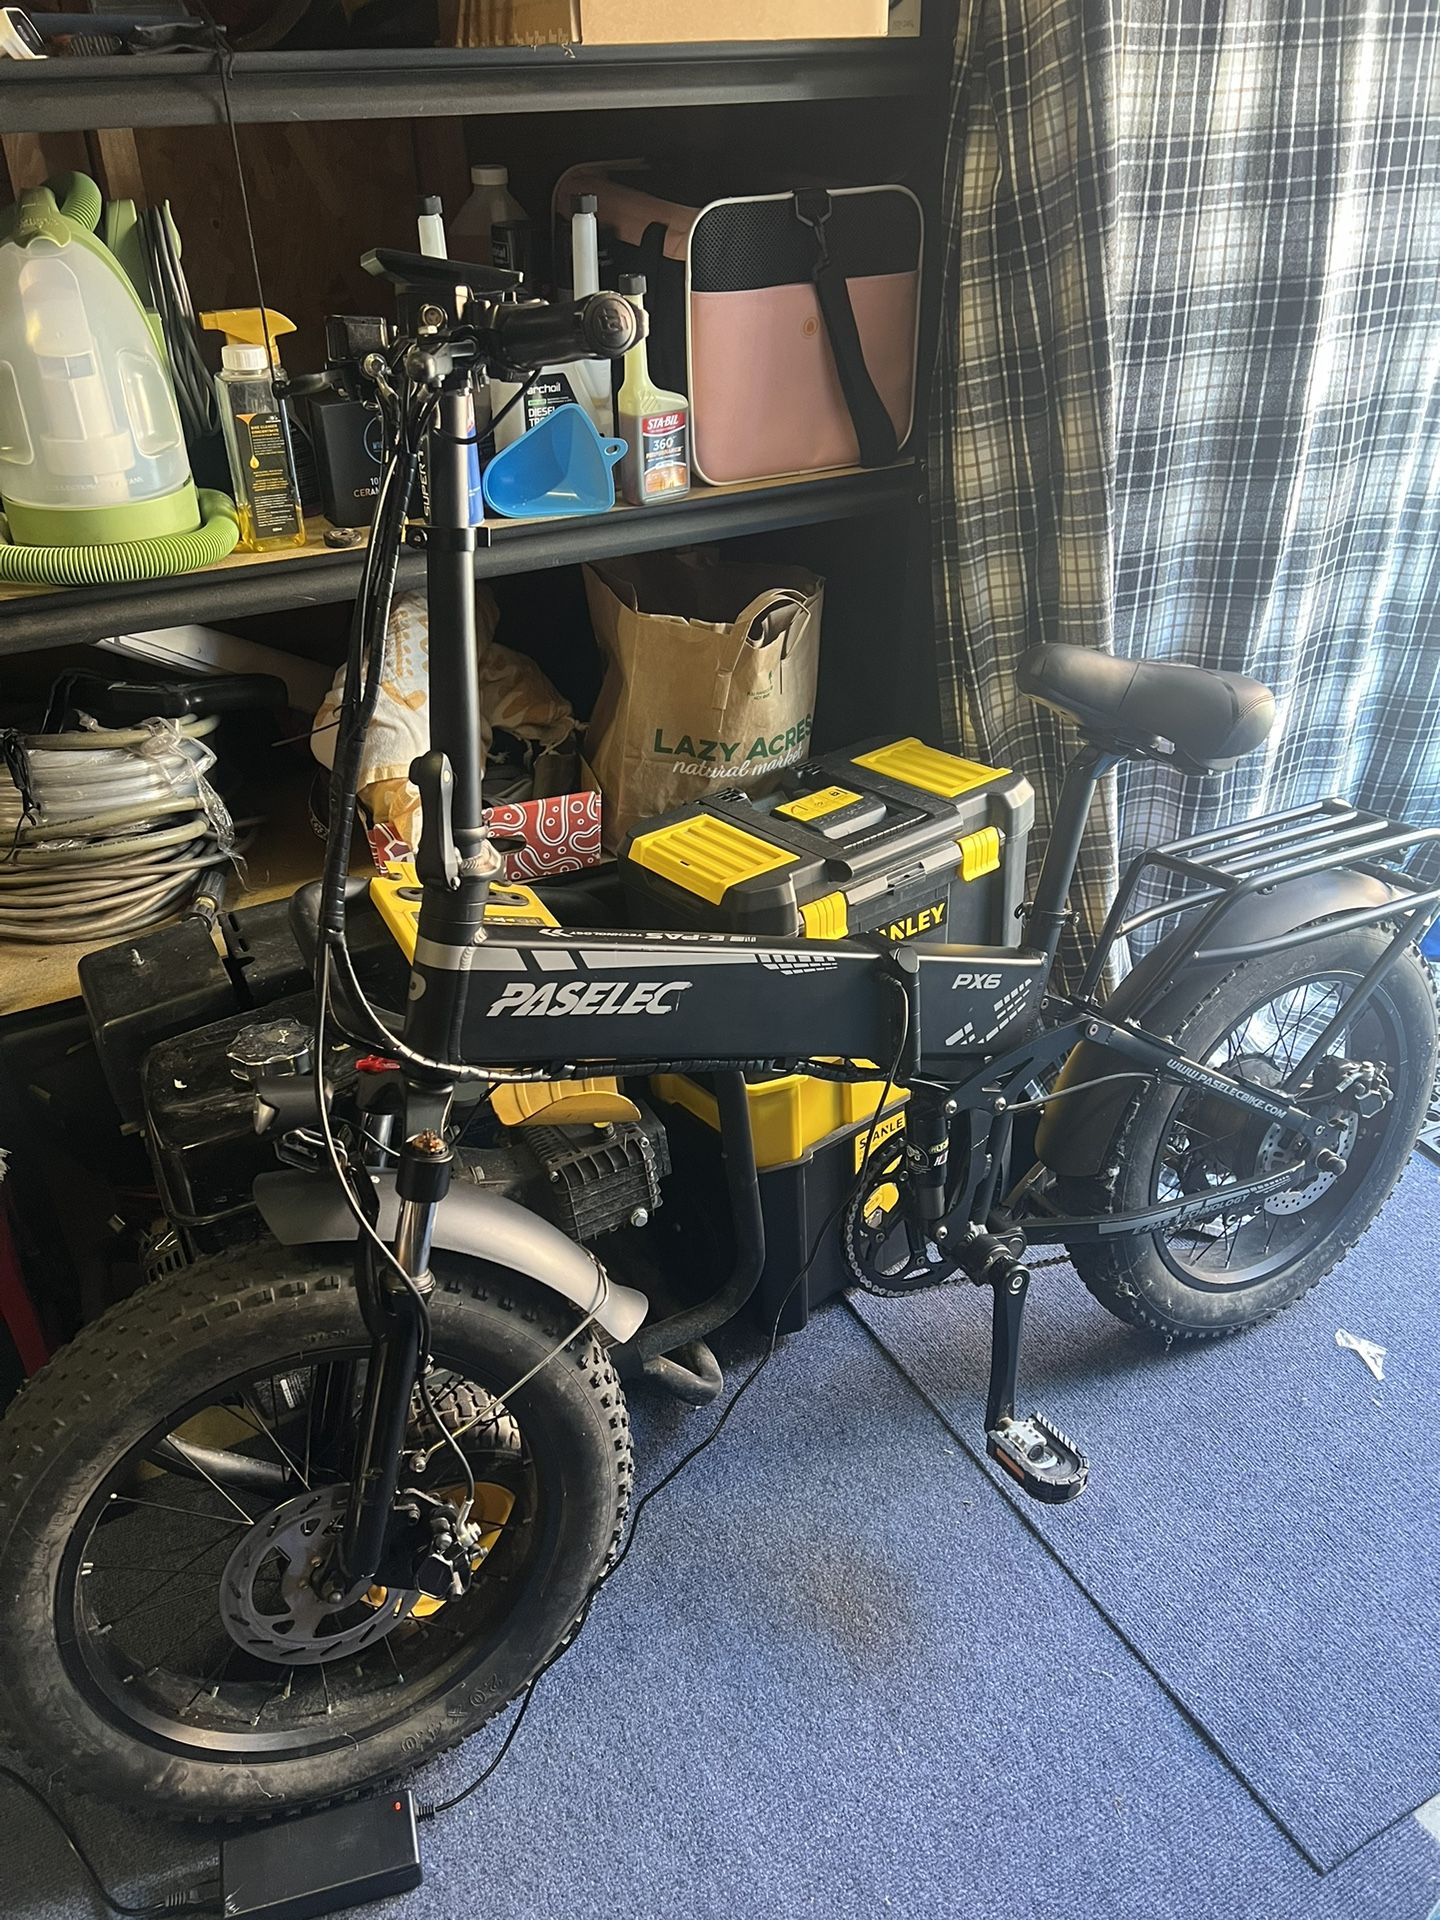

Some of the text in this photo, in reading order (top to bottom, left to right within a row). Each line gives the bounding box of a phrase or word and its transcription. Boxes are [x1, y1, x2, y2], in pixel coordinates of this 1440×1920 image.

[527, 382, 561, 395] archoil
[528, 406, 556, 418] DIESE
[653, 437, 674, 451] 360
[653, 713, 813, 762] LAZY ACRES
[672, 744, 804, 779] natural market
[569, 930, 725, 942] E-PAS TECHNOLOGY
[952, 973, 1003, 990] PX6
[486, 981, 693, 1017] PASELEC
